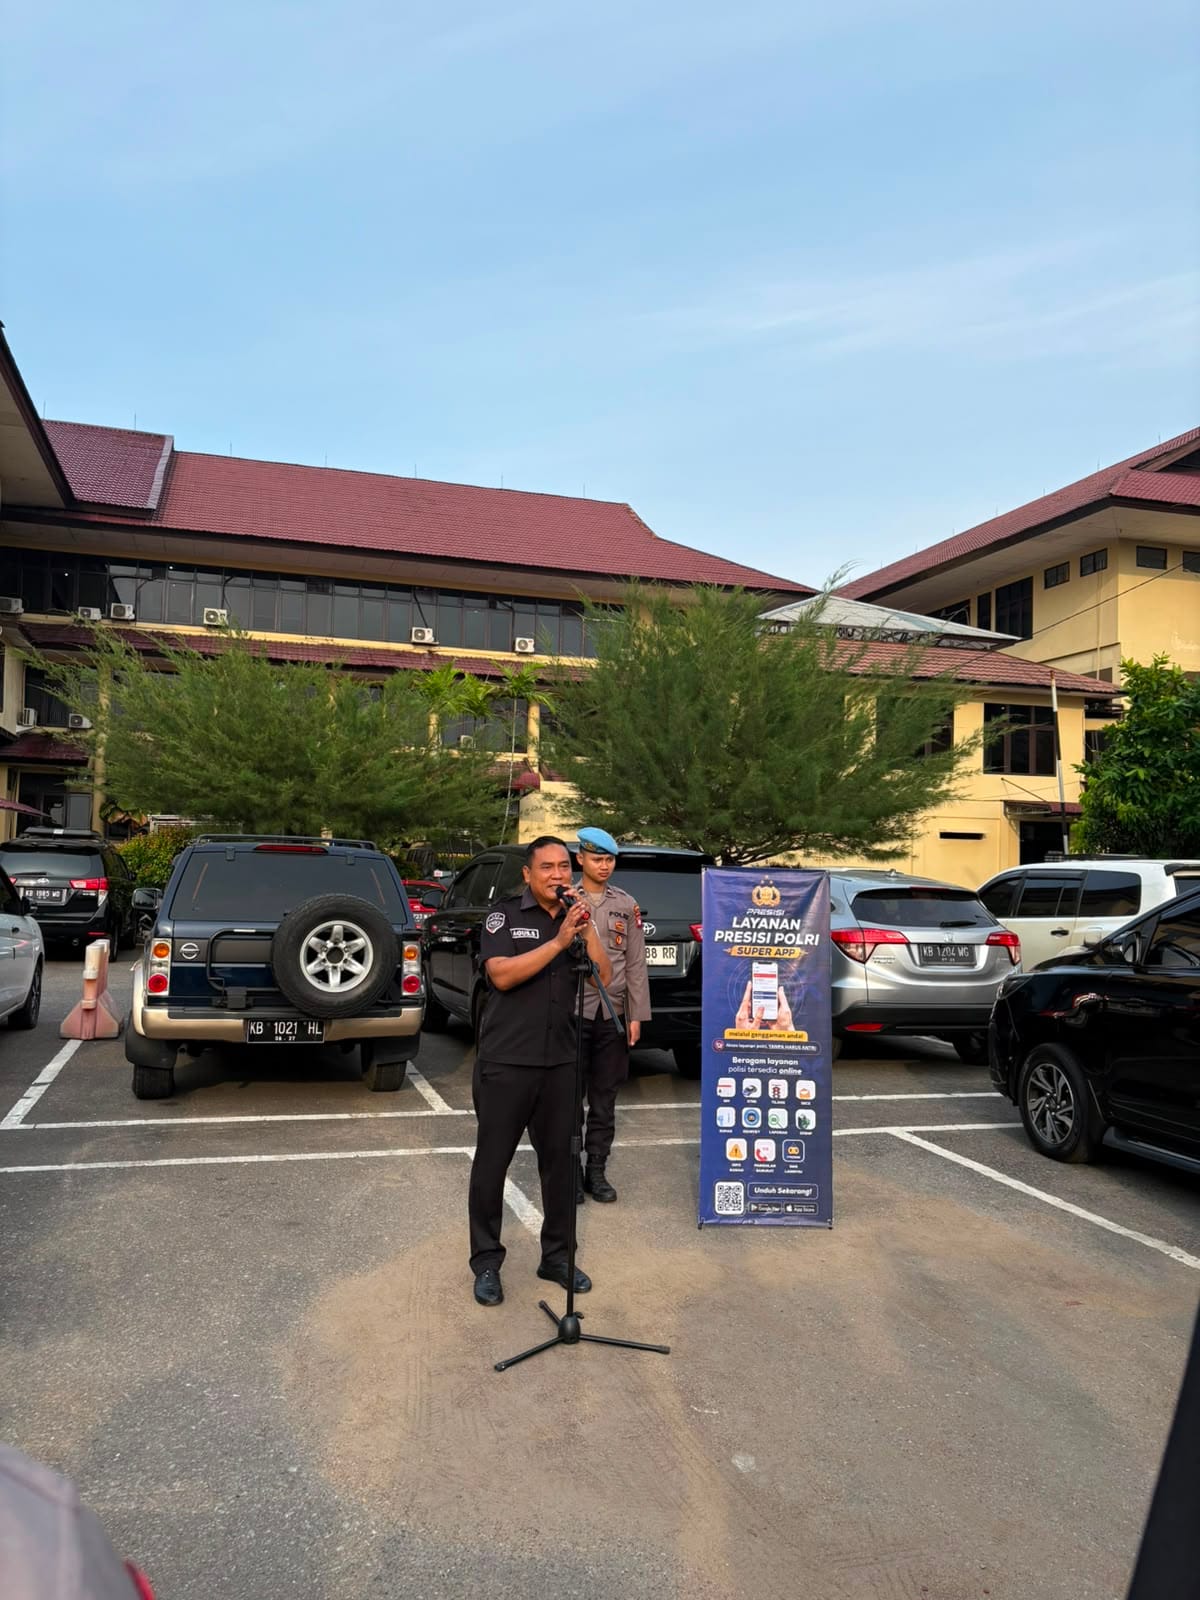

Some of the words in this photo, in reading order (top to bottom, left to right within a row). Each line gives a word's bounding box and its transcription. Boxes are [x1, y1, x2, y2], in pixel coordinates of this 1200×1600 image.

[732, 916, 801, 930] LAYANAN
[714, 930, 771, 944] PRESISI
[774, 932, 820, 946] POLRI
[662, 947, 675, 959] RR
[736, 946, 772, 956] SUPER
[774, 947, 796, 957] APP
[922, 946, 933, 957] KB
[249, 1021, 264, 1035] KB
[273, 1021, 298, 1035] 1021
[307, 1021, 323, 1035] HL
[732, 1056, 767, 1066] Beragam
[767, 1057, 798, 1067] layanan
[728, 1066, 746, 1075] polisi
[778, 1067, 802, 1075] online
[754, 1186, 777, 1194] Unduh
[777, 1186, 813, 1197] Sekarang!
